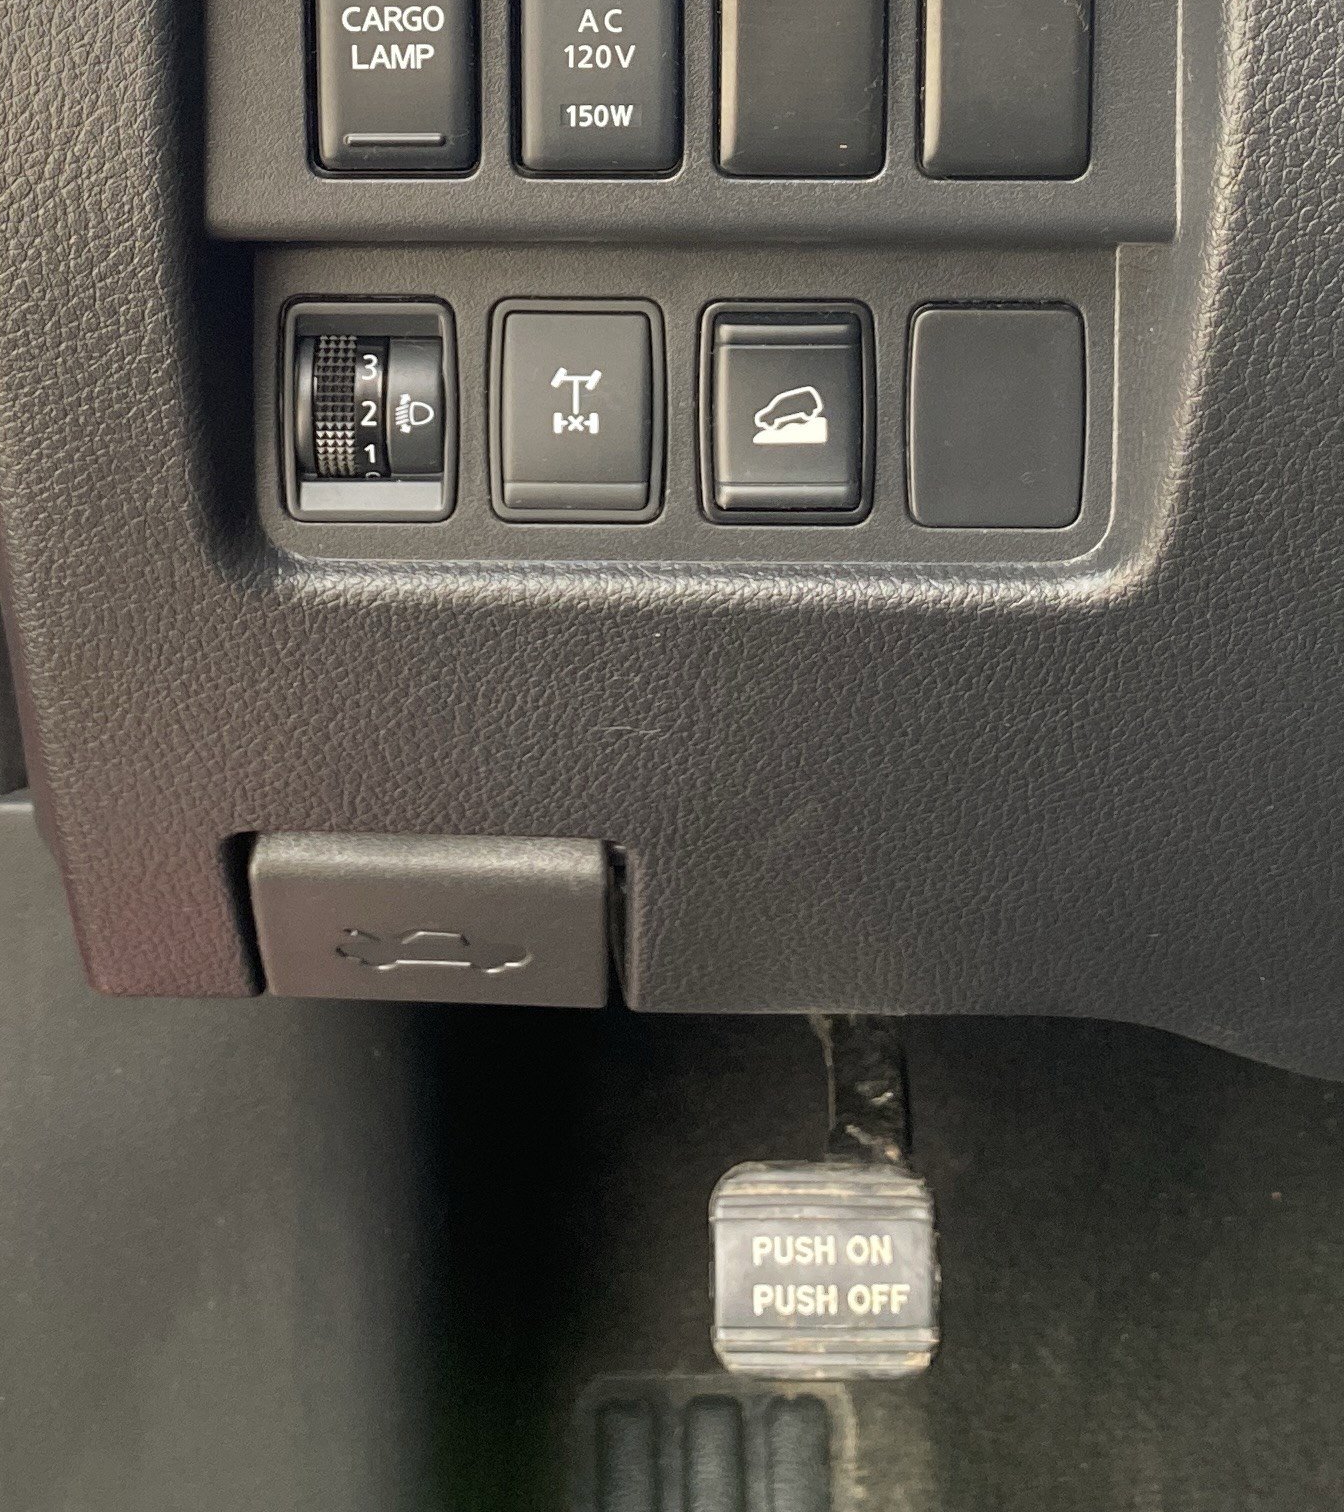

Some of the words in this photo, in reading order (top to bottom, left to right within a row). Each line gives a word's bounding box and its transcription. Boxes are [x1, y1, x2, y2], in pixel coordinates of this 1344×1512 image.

[341, 5, 445, 32] CARGO
[351, 43, 435, 70] LAMP
[566, 104, 634, 128] 150W
[360, 354, 378, 382] 3
[360, 400, 378, 427] 2
[364, 443, 376, 464] 1
[752, 1235, 836, 1266] PUSH
[845, 1233, 894, 1266] ON
[753, 1284, 838, 1317] PUSH
[847, 1283, 911, 1315] OFF
